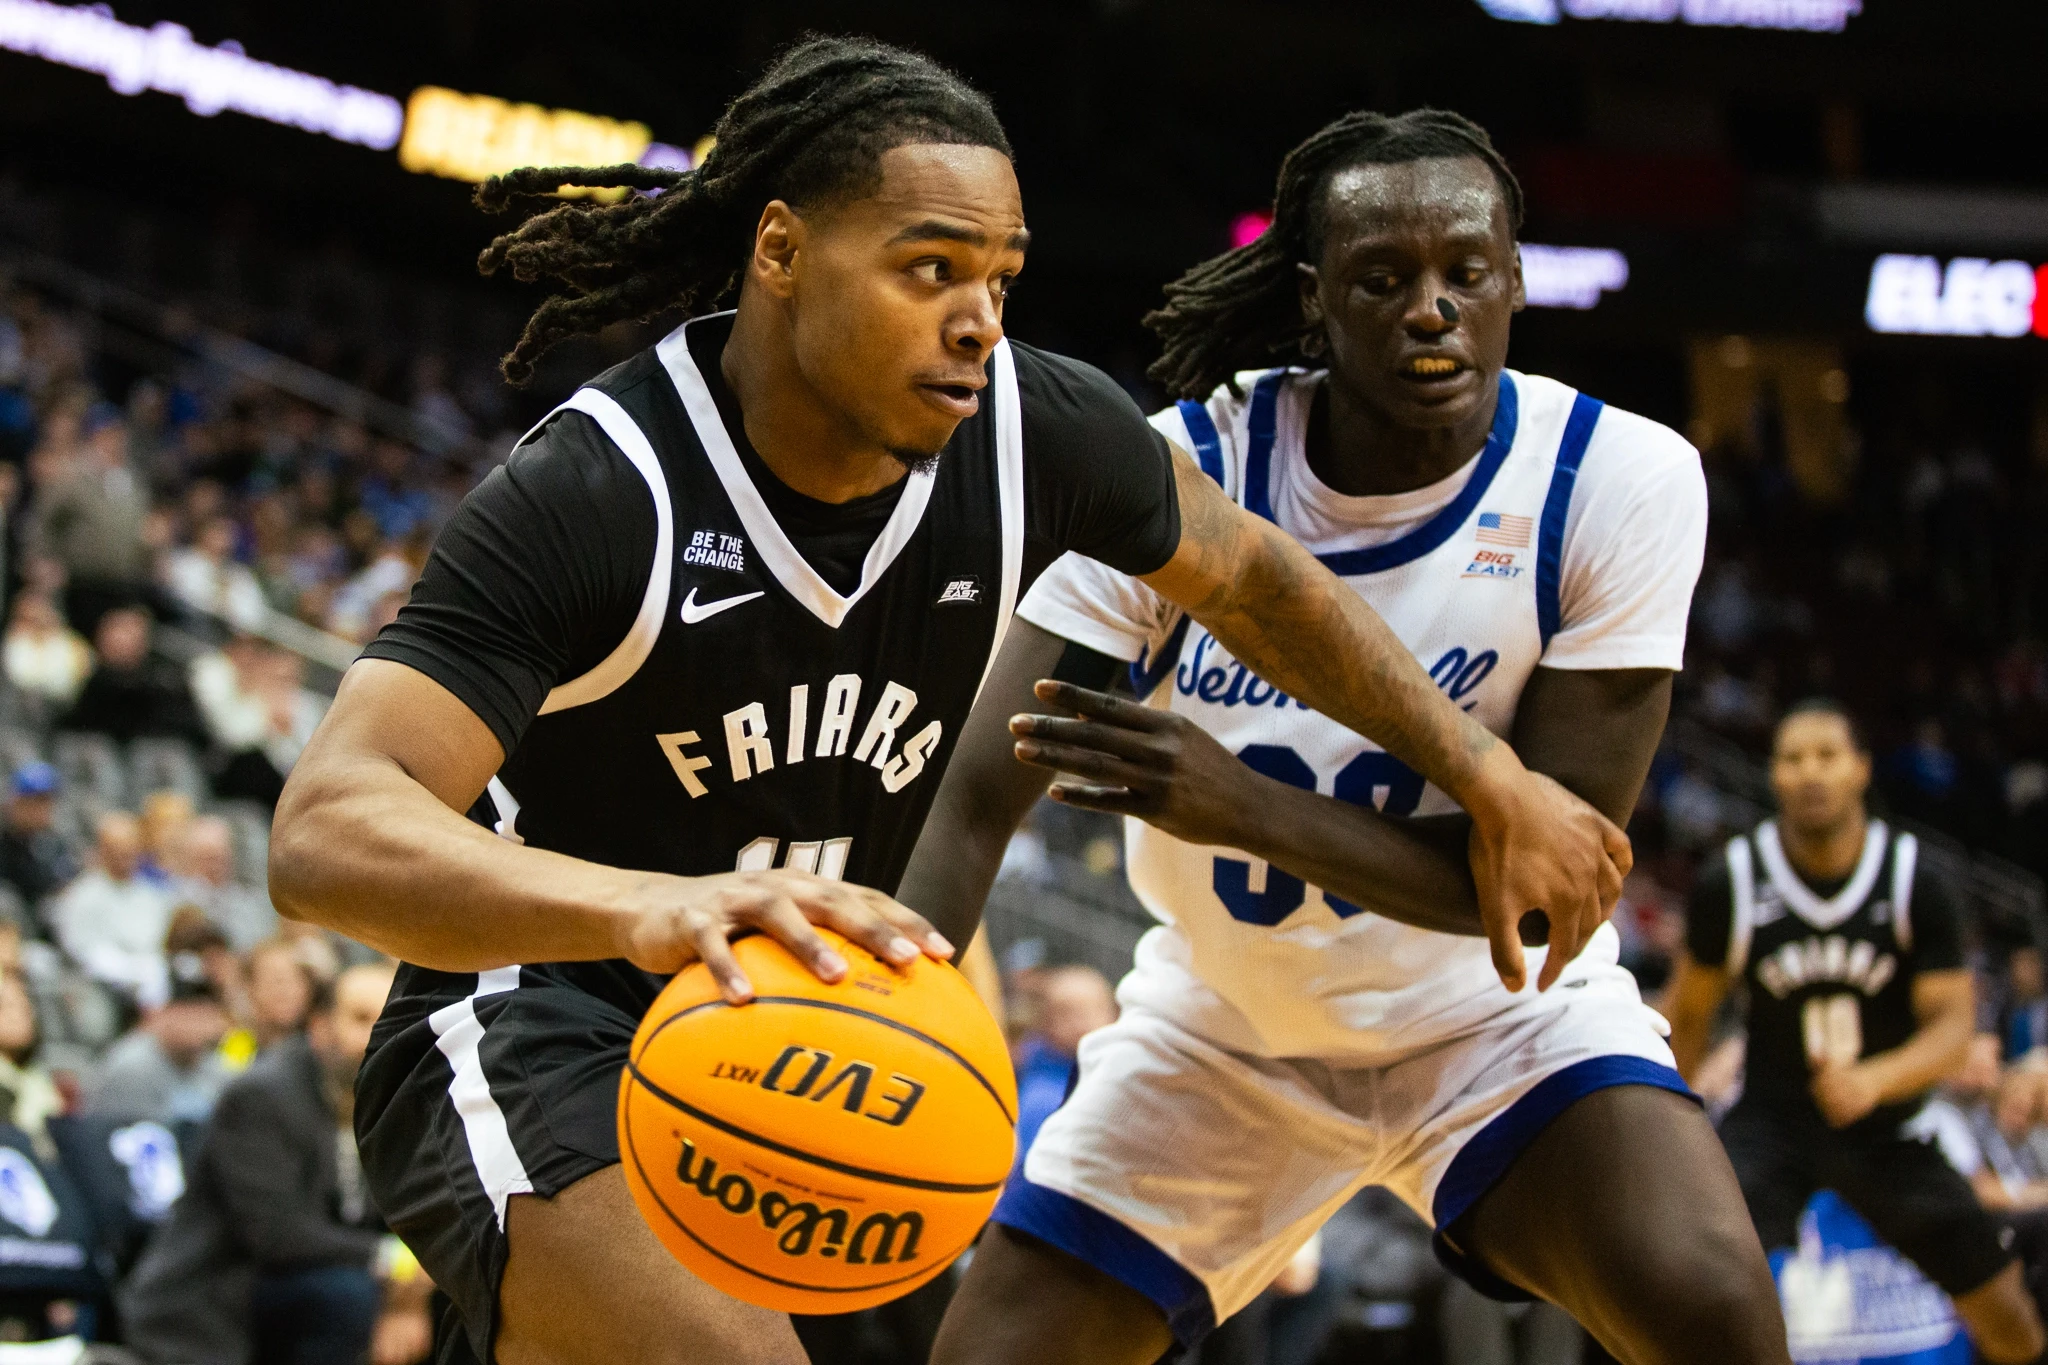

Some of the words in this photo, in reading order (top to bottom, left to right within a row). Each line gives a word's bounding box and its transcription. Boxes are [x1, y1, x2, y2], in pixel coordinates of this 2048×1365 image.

[691, 531, 715, 548] BE
[719, 534, 744, 554] THE
[683, 546, 744, 571] CHANGE
[1474, 549, 1516, 566] BIG
[1465, 561, 1525, 578] EAST
[940, 590, 979, 599] EAST
[945, 580, 974, 590] BIG
[655, 673, 942, 799] FRIARS
[708, 1061, 760, 1084] NXT
[760, 1045, 926, 1127] EVO
[676, 1138, 924, 1264] Wilson
